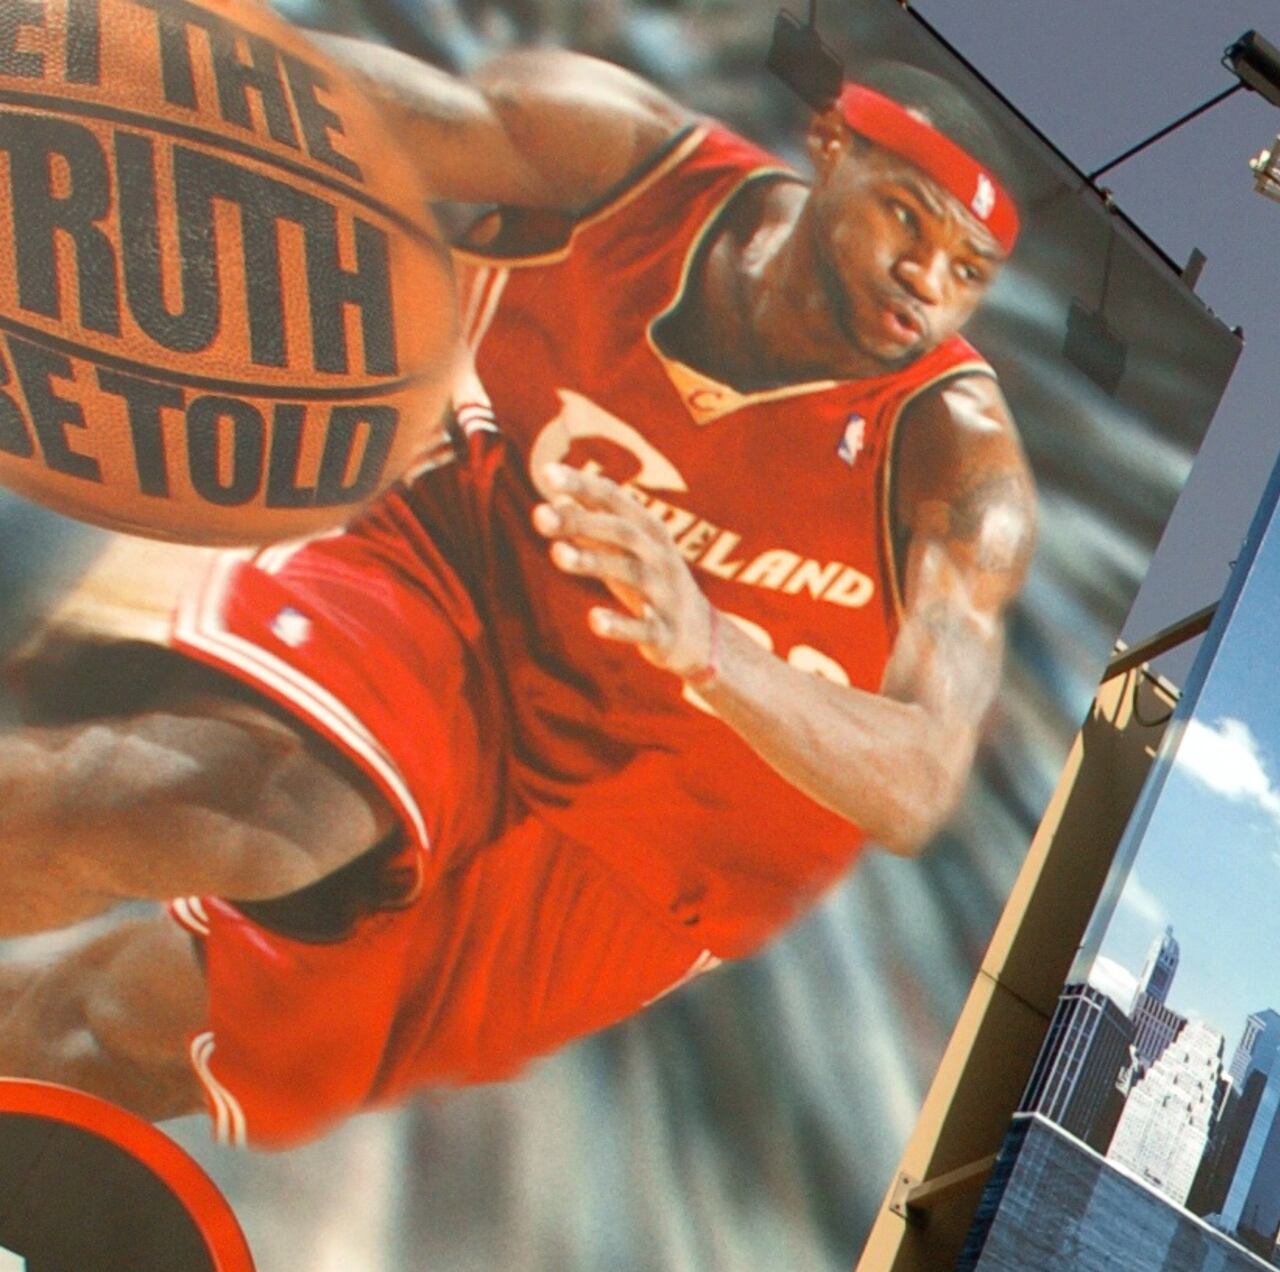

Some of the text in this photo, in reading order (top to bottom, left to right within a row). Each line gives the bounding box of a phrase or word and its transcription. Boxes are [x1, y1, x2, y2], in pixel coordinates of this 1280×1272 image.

[130, 0, 364, 184] THE
[0, 113, 398, 376] RUTH
[95, 366, 400, 508] TOLD
